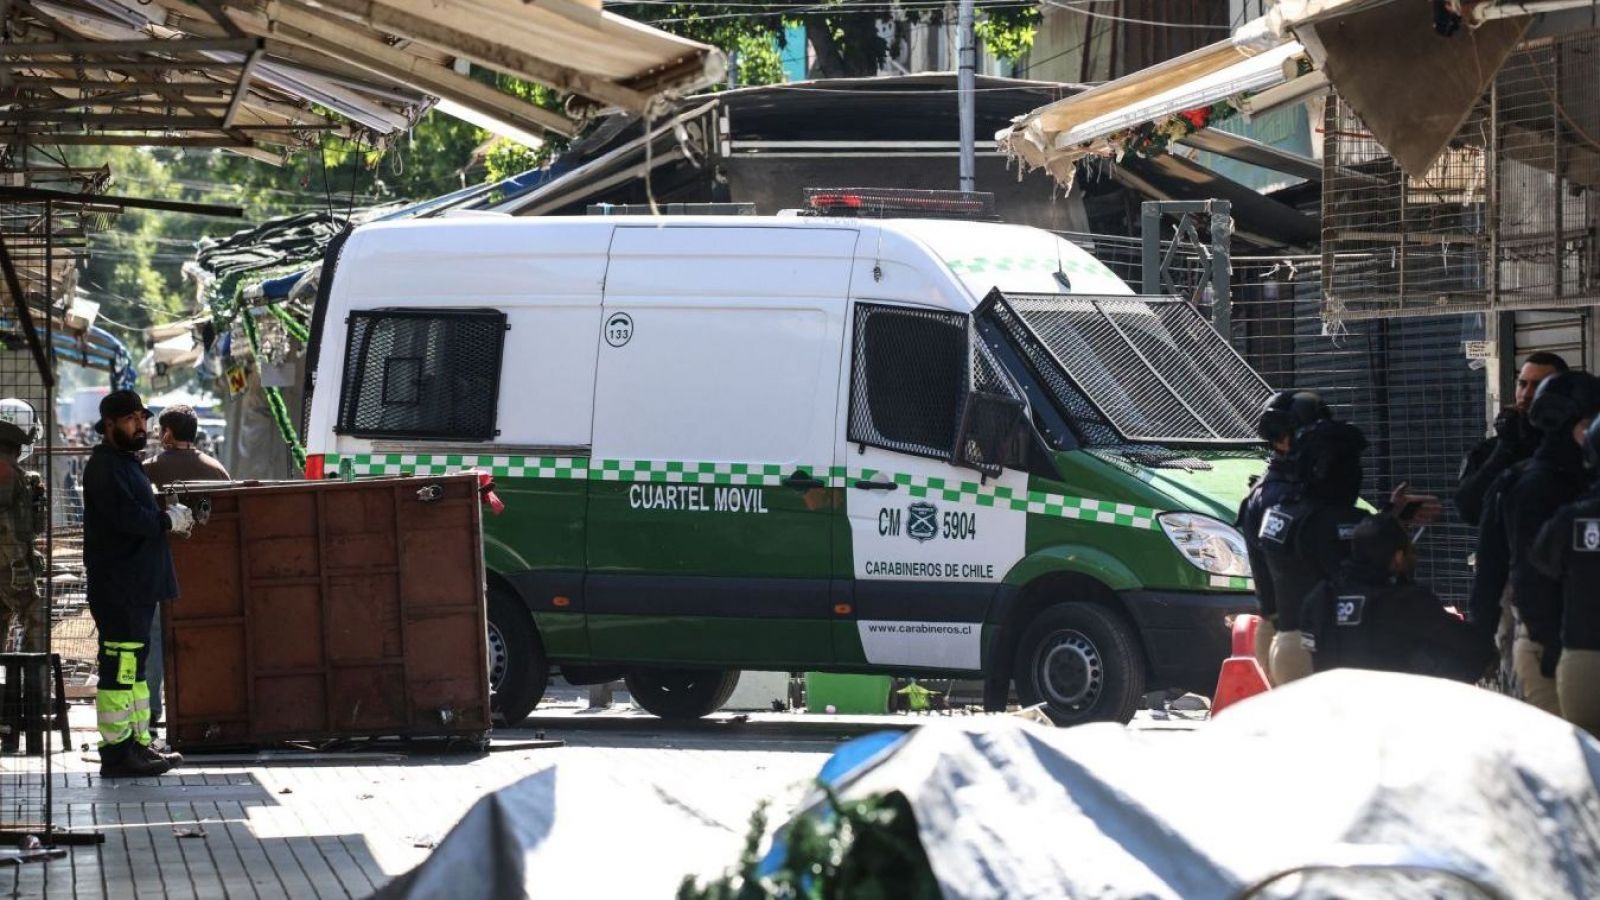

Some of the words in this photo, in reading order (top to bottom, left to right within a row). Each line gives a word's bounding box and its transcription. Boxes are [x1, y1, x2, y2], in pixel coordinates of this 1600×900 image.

[610, 329, 628, 339] 133
[629, 484, 710, 511] CUARTEL
[714, 487, 769, 514] MOVIL
[878, 507, 902, 537] CM
[943, 511, 976, 540] 5904
[865, 561, 942, 577] CARABINEROS
[944, 563, 960, 577] DE
[961, 564, 994, 578] CHILE
[868, 624, 972, 635] www.carabineros.cl
